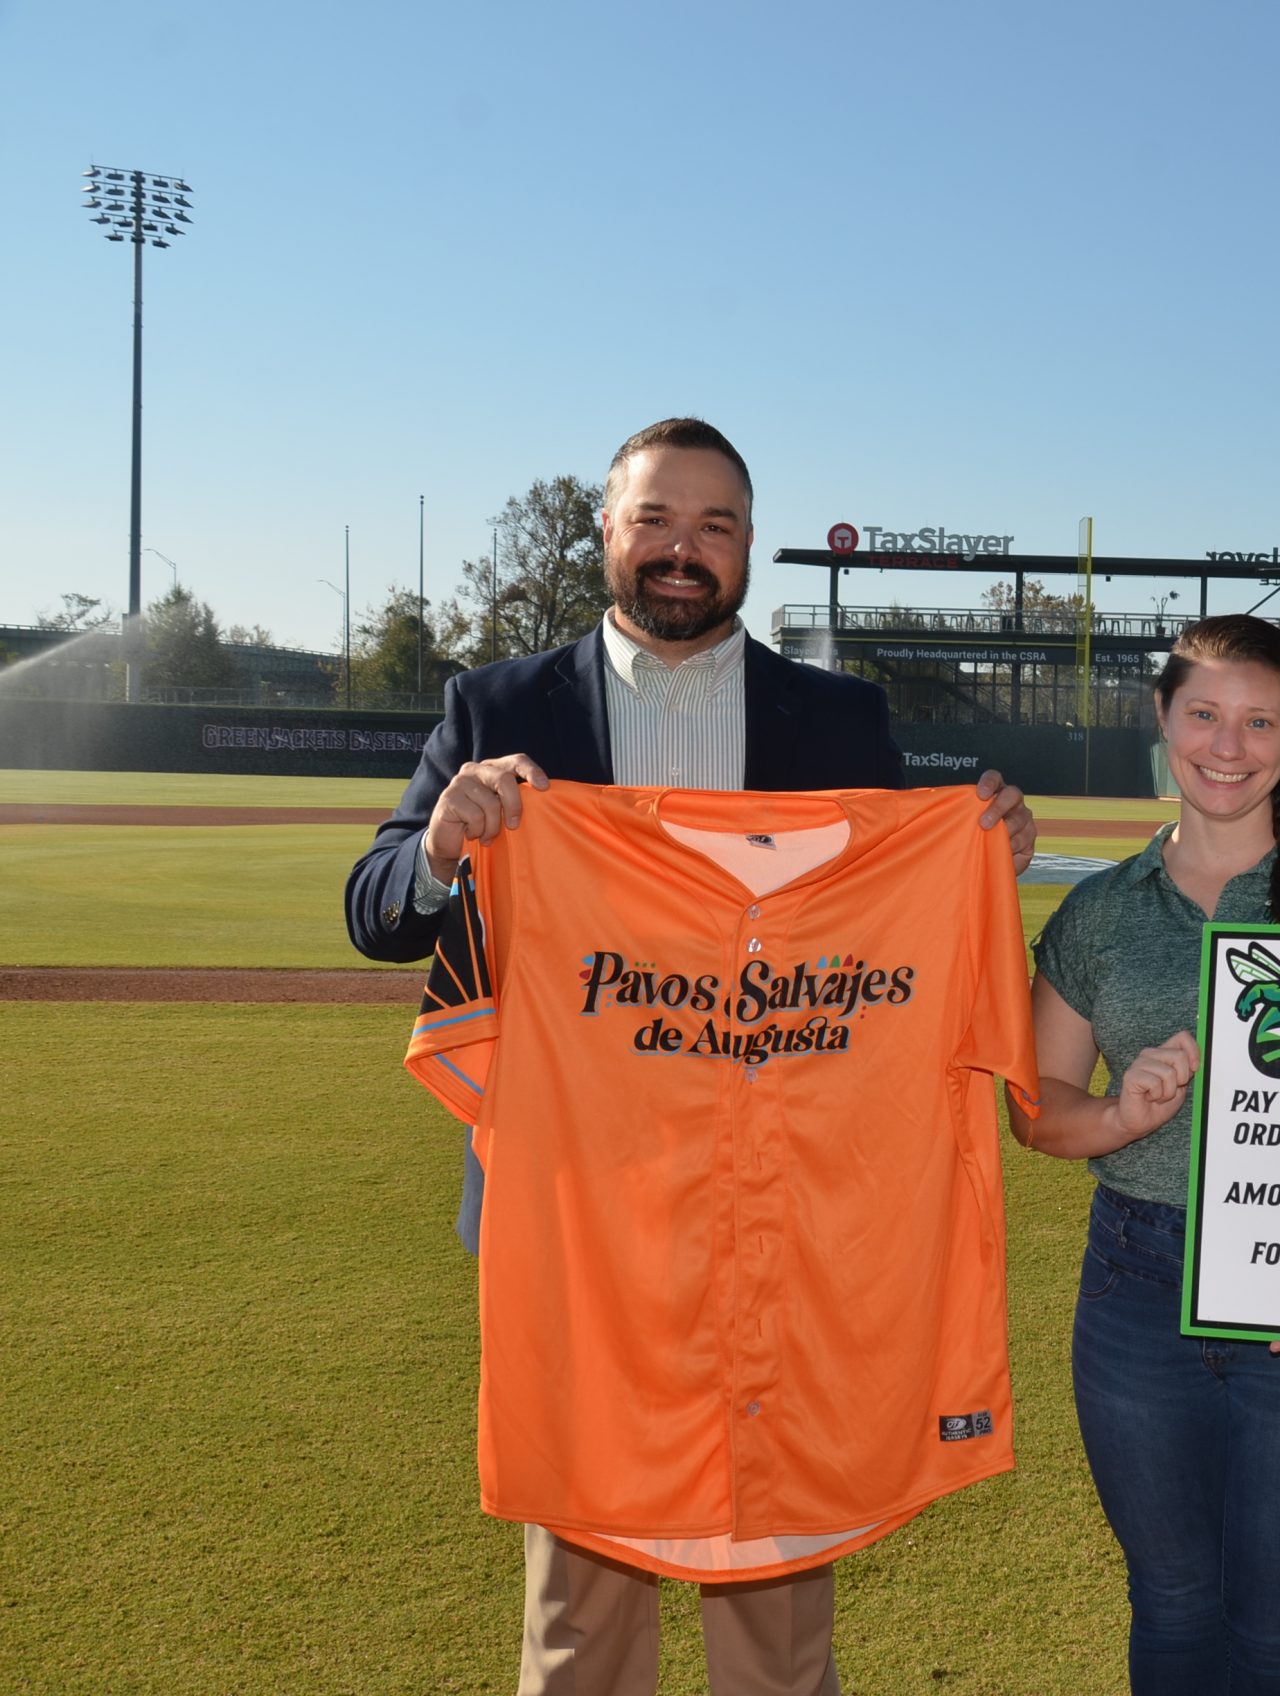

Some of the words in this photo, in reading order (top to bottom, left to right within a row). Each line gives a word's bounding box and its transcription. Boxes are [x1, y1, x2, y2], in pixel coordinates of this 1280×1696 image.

[863, 526, 1014, 562] TaxSlayer
[868, 555, 959, 569] TERRACE
[876, 647, 914, 660] Proudly
[916, 648, 988, 661] Headquartered
[990, 650, 999, 660] in
[1001, 650, 1017, 661] the
[1019, 651, 1047, 662] CSRA
[1095, 653, 1113, 663] Est.
[1117, 654, 1140, 664] 1965
[202, 724, 347, 751] GREENJACKETS
[1066, 732, 1084, 742] 318
[903, 752, 979, 770] TaxSlayer
[581, 951, 720, 1016] Pavos
[724, 959, 914, 1024] Salvajes
[633, 1017, 684, 1053] de
[688, 1015, 850, 1066] Augusta
[1229, 1089, 1279, 1114] PAY
[976, 1416, 991, 1430] 52
